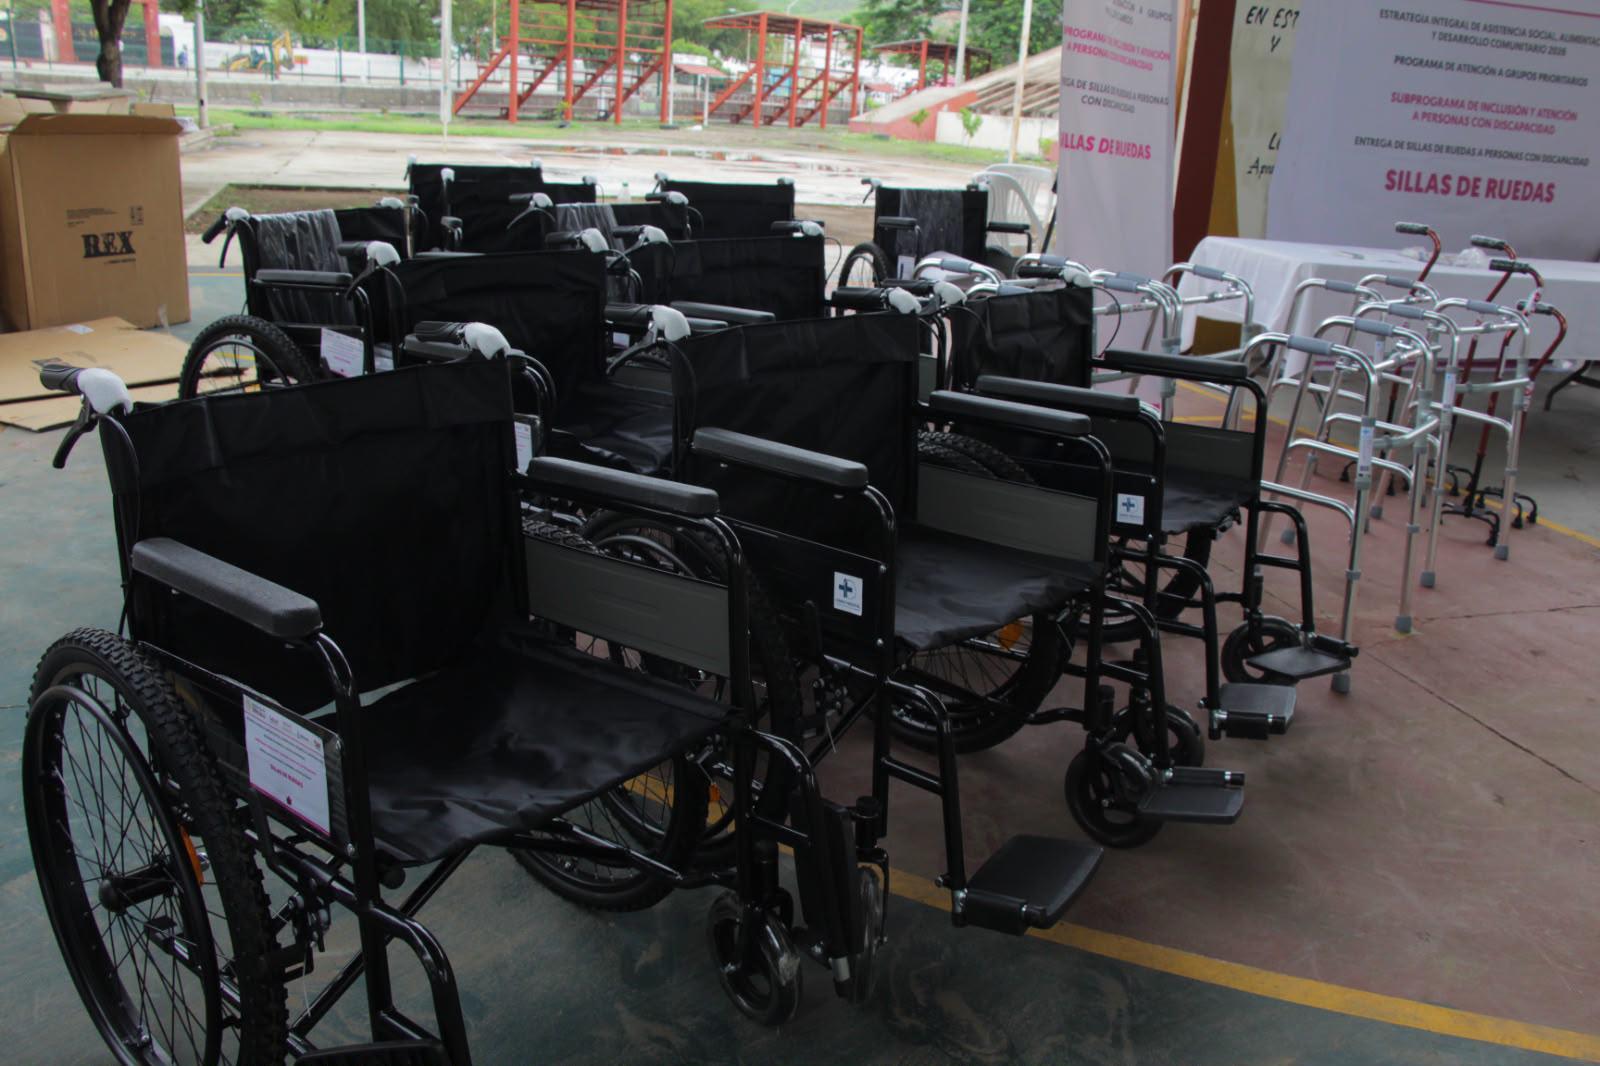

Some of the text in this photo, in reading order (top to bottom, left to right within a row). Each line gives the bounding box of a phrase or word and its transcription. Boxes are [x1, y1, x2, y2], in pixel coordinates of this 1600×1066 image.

[1245, 6, 1270, 24] EN
[1380, 10, 1429, 24] ESTRATEGIA
[1431, 17, 1469, 30] INTEGRAL
[1470, 22, 1481, 32] DE
[1482, 24, 1527, 37] ASISTENCIA
[1270, 35, 1281, 52] Y
[1431, 30, 1437, 40] Y
[1438, 33, 1490, 46] DESARROLLO
[1490, 39, 1547, 53] COMUNITARIO
[1394, 55, 1588, 87] PROGRAMA DE ATENCIÓN A GRUPOS PRIORITARIOS
[1076, 80, 1087, 90] DE
[1081, 95, 1102, 106] CON
[1391, 92, 1466, 109] SUBPROGRAMA
[1466, 100, 1480, 111] DE
[1481, 102, 1528, 116] INCLUSIÓN
[1529, 106, 1537, 116] Y
[1412, 110, 1556, 135] A PERSONAS CON DISCAPACIDAD
[1098, 138, 1114, 154] DE
[1115, 140, 1152, 160] RUEDAS
[1354, 136, 1393, 148] ENTREGA
[1394, 140, 1406, 150] DE
[1406, 141, 1433, 152] SILLAS
[1434, 143, 1444, 153] DE
[1445, 145, 1477, 156] RUEDAS
[1484, 148, 1524, 160] PERSONAS
[1524, 152, 1541, 162] CON
[1541, 155, 1590, 167] DISCAPACIDAD
[1384, 169, 1556, 203] SILLAS DE RUEDAS
[80, 230, 137, 258] REX
